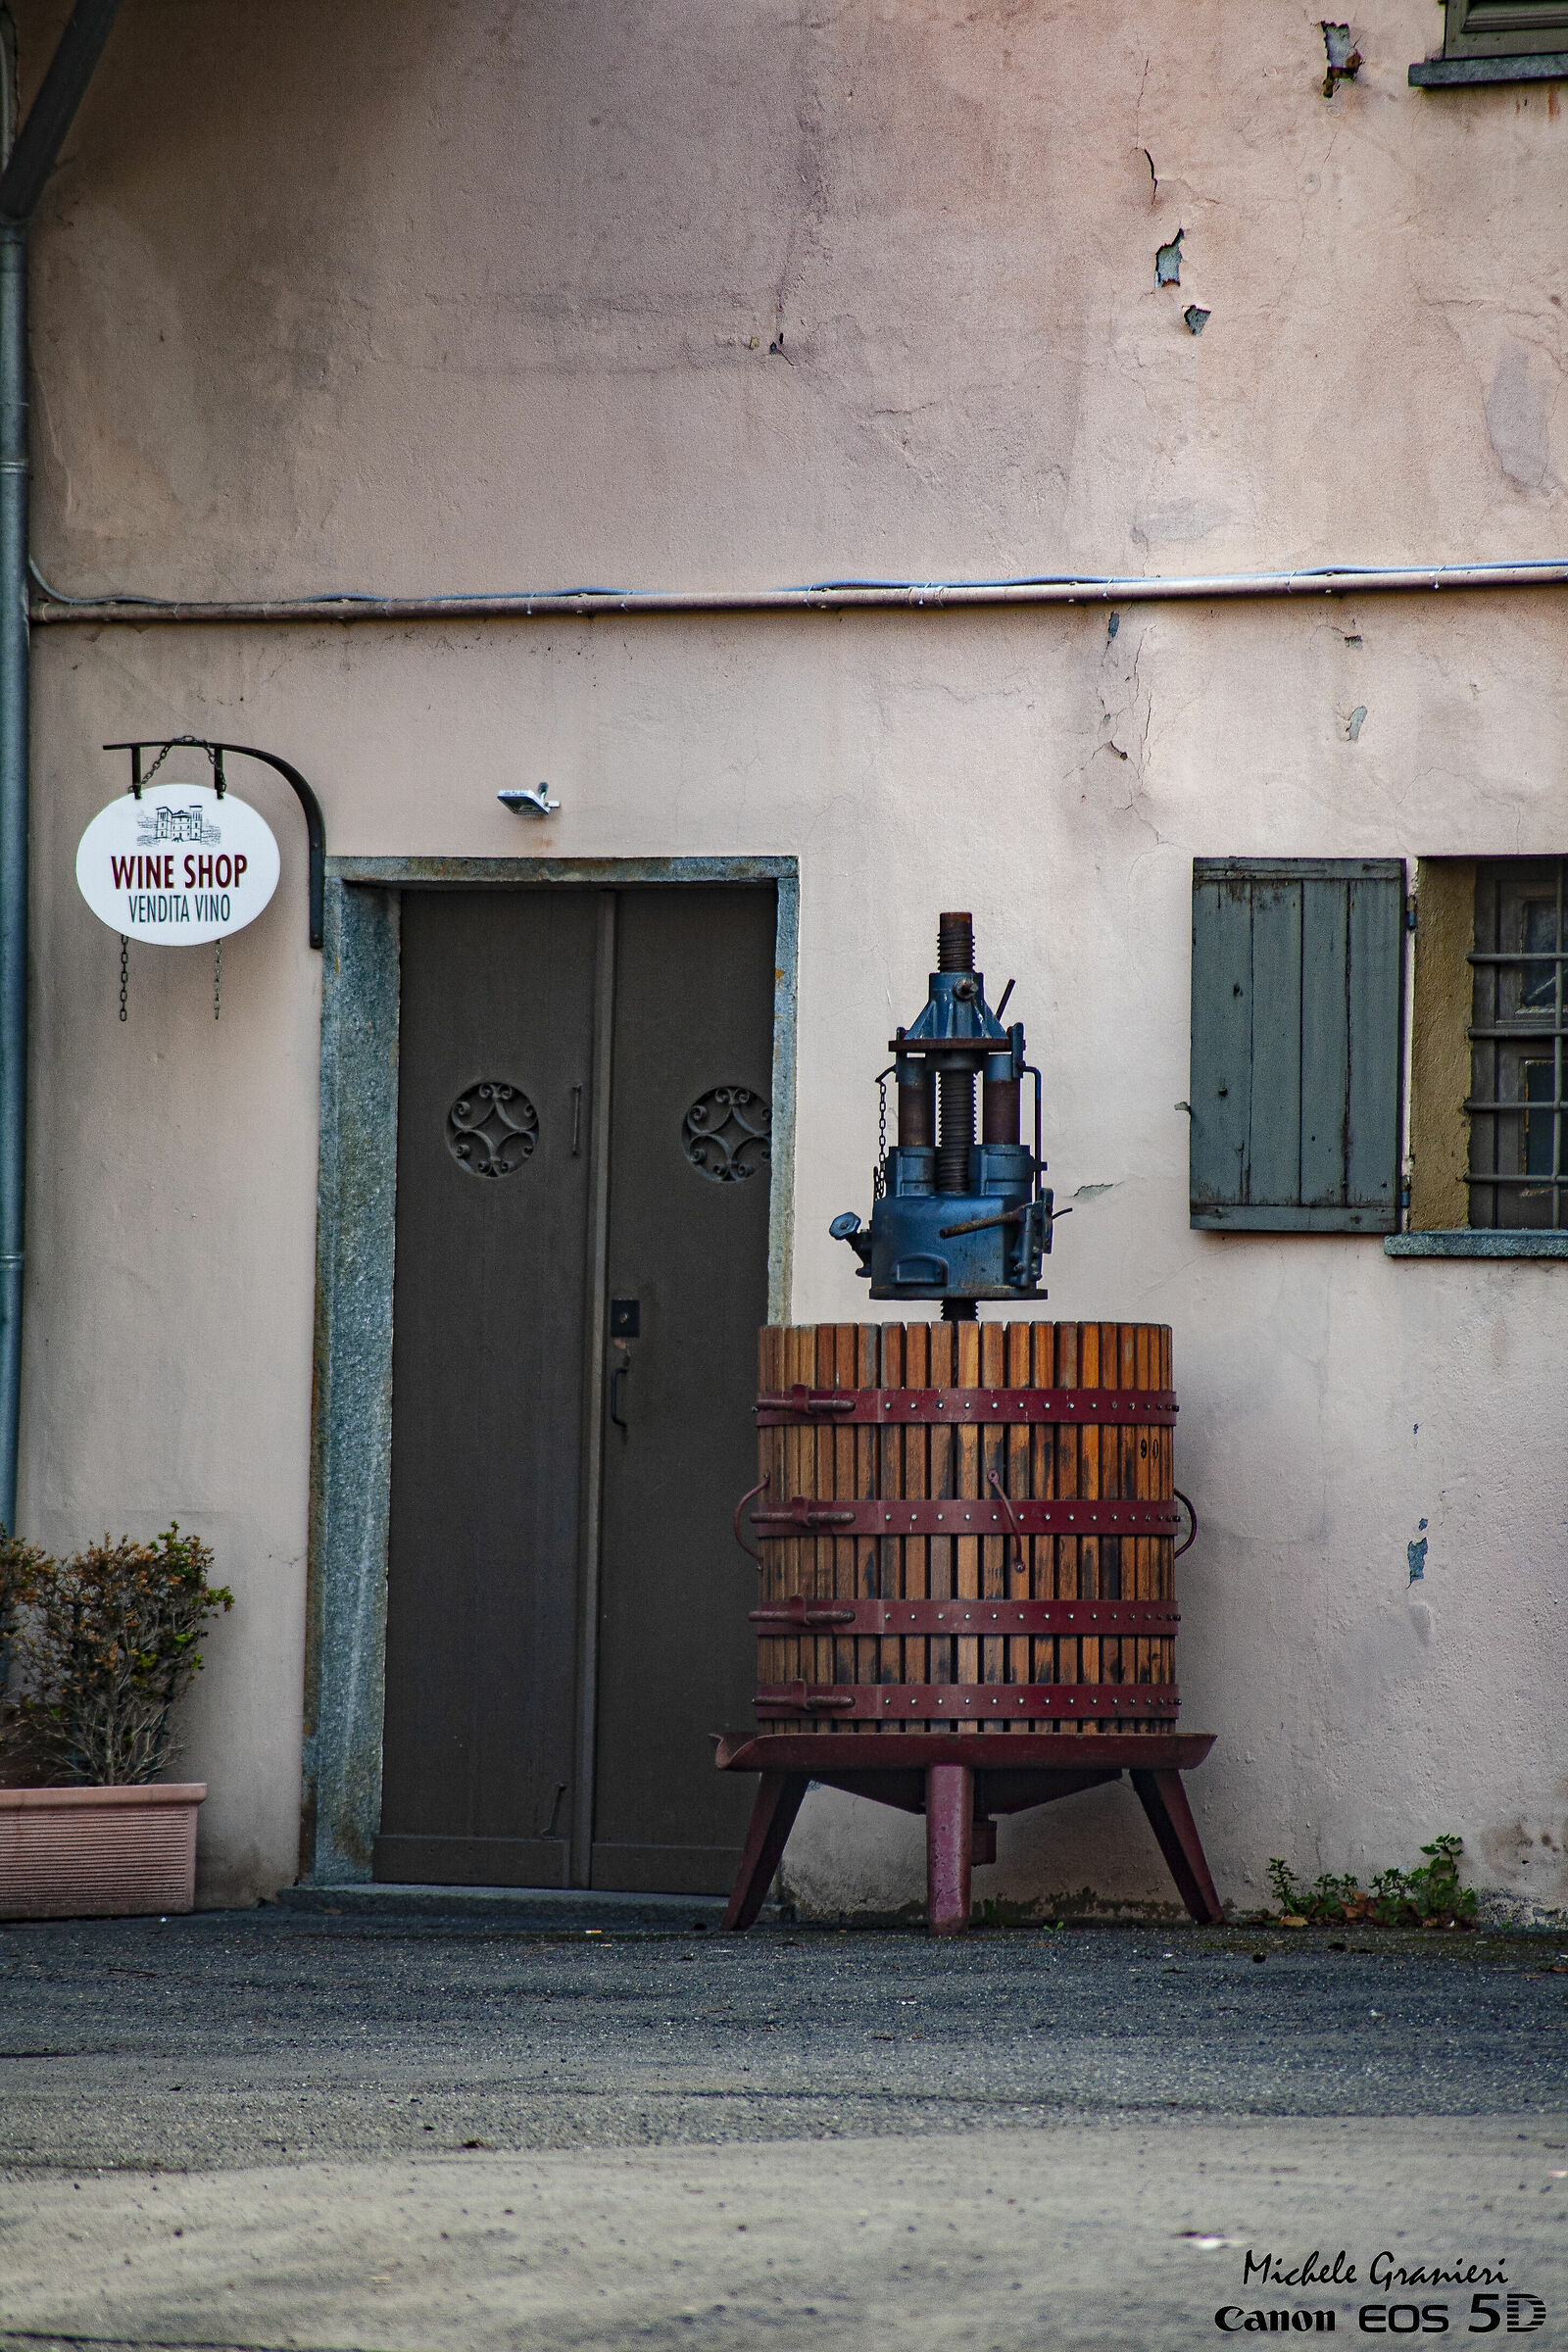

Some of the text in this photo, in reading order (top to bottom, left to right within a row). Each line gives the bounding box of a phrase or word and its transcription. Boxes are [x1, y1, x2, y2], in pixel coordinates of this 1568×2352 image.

[111, 854, 247, 889] WINE SHOP
[128, 894, 230, 923] VENDITA VINO
